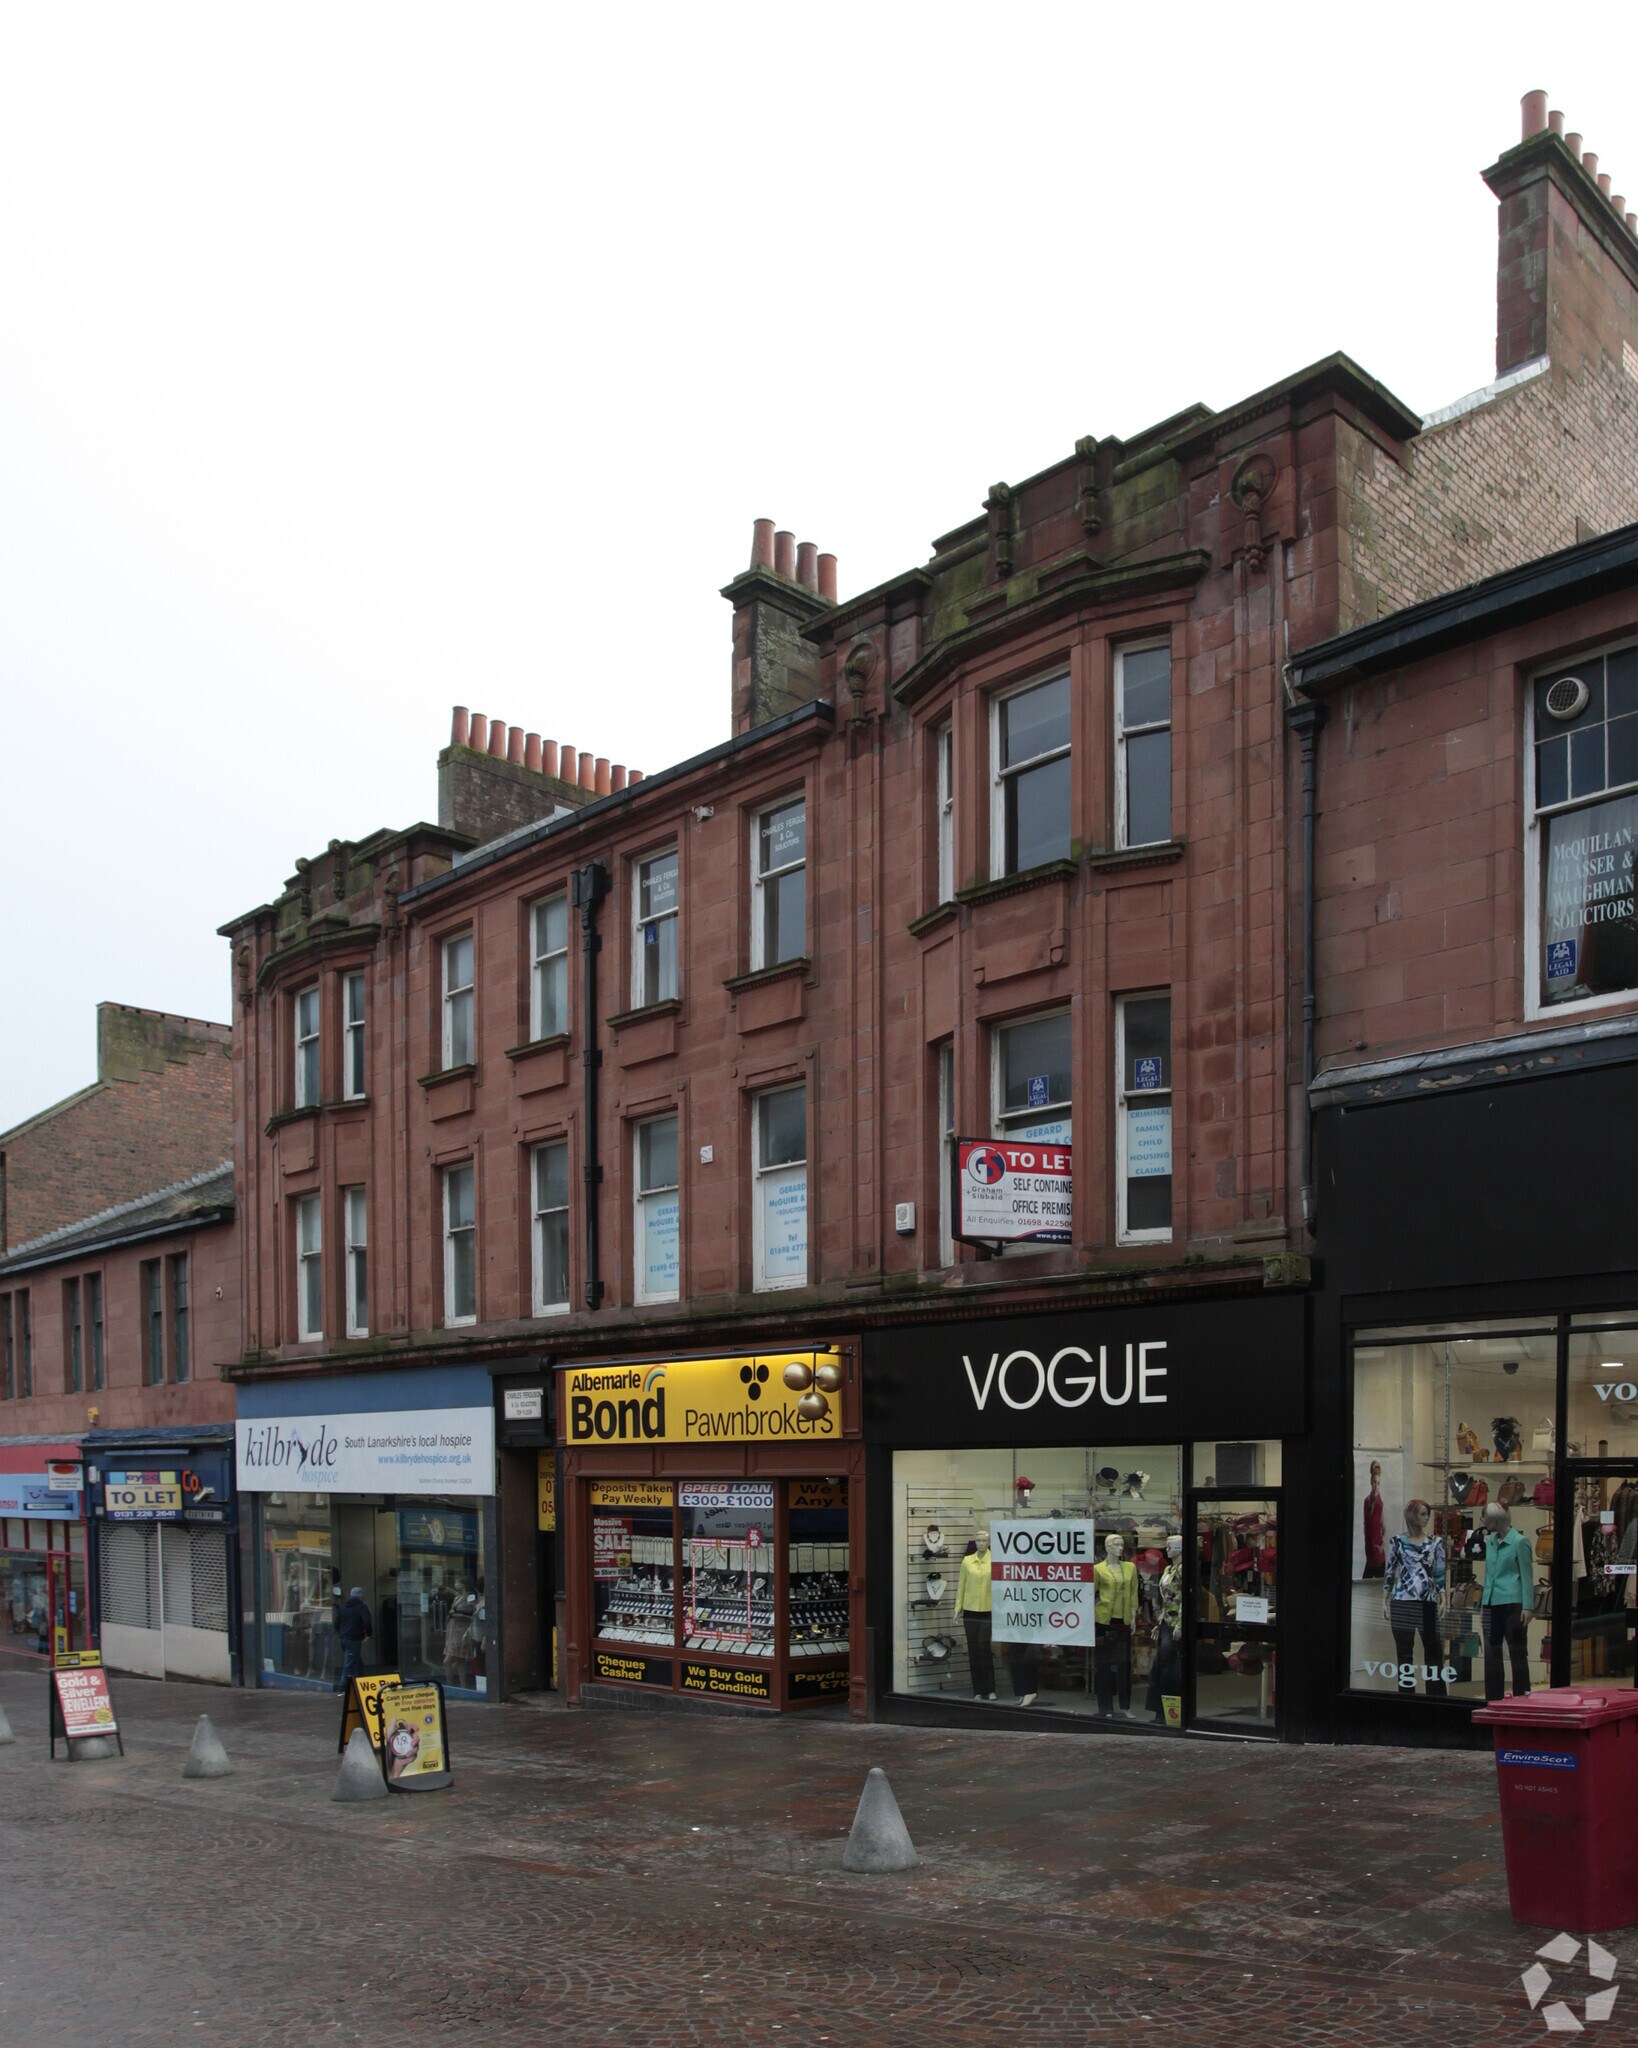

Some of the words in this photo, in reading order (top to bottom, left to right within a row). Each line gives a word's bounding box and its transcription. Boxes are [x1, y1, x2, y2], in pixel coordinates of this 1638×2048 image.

[1555, 854, 1614, 884] GLASSER
[1622, 851, 1632, 870] &
[1553, 874, 1634, 906] WAUGHMAN
[1553, 898, 1634, 932] SOLICITORS
[1549, 962, 1574, 972] LEGAL
[1554, 968, 1569, 977] AID
[1130, 1108, 1170, 1118] CRIMINAL
[1026, 1125, 1062, 1138] GERARD
[1136, 1124, 1164, 1132] FAMILY
[1007, 1151, 1036, 1168] TO
[1130, 1152, 1169, 1161] HOUSING
[780, 1183, 806, 1194] GERARD
[1014, 1178, 1031, 1191] SELF
[769, 1196, 798, 1207] McGUIRE
[1012, 1200, 1038, 1214] OFFICE
[978, 1216, 1014, 1225] Enquiries
[572, 1370, 641, 1392] Albemarle
[962, 1341, 1167, 1410] VOGUE
[572, 1387, 666, 1440] Bond
[345, 1436, 365, 1448] South
[367, 1434, 417, 1449] Lanarkshire's
[418, 1434, 437, 1447] local
[440, 1434, 472, 1449] hospice
[245, 1424, 338, 1474] kilbryde
[378, 1453, 472, 1466] www.kilbrydehospice.org.uk
[301, 1466, 338, 1487] hospice
[592, 1483, 638, 1494] Deposits
[639, 1483, 672, 1493] Taken
[683, 1484, 728, 1493] SPEED
[731, 1484, 772, 1493] LOAN
[799, 1484, 832, 1494] We
[111, 1492, 136, 1504] TO
[144, 1491, 176, 1503] LET
[602, 1495, 621, 1504] Pay
[622, 1494, 662, 1505] Weekly
[682, 1496, 773, 1506] £300-£1000
[794, 1496, 834, 1508] Any
[594, 1535, 632, 1550] SALE
[997, 1531, 1085, 1555] VOGUE
[1003, 1565, 1042, 1580] FINAL
[1047, 1565, 1081, 1580] SALE
[1003, 1587, 1027, 1601] ALL
[1031, 1588, 1082, 1603] STOCK
[1007, 1612, 1043, 1627] MUST
[1049, 1611, 1080, 1629] GO
[597, 1655, 645, 1670] Cheques
[601, 1666, 642, 1680] Cashed
[688, 1666, 706, 1676] We
[709, 1668, 732, 1682] Buy
[735, 1672, 762, 1684] Gold
[1362, 1660, 1458, 1688] vogue
[59, 1676, 88, 1688] Gold
[90, 1676, 101, 1685] &
[360, 1682, 377, 1692] We
[685, 1677, 705, 1689] Any
[710, 1680, 767, 1696] Condition
[60, 1688, 96, 1698] Silver
[63, 1695, 110, 1712] JEWELLERY
[1504, 1752, 1569, 1763] EnviroScot
